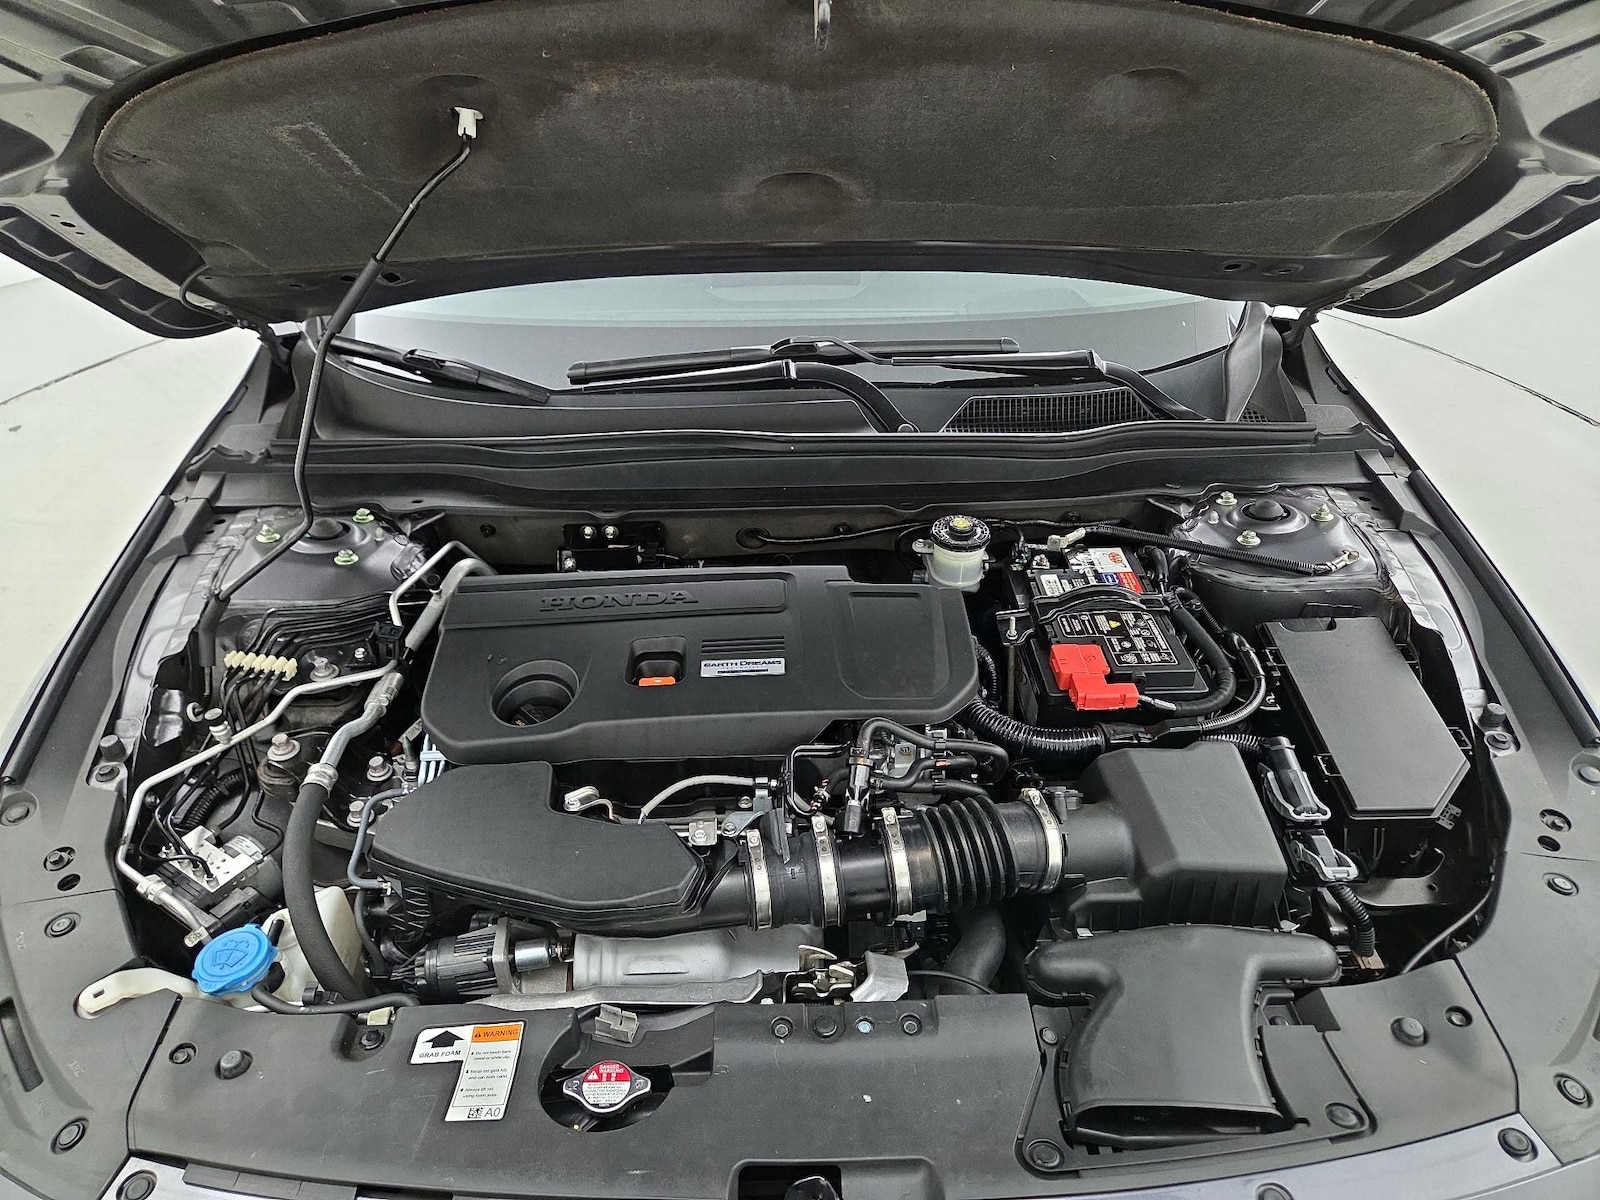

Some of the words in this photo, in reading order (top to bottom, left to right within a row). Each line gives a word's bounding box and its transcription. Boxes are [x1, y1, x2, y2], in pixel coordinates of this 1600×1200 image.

[538, 590, 699, 612] HONDA
[482, 1029, 518, 1038] WARNING
[484, 1107, 501, 1117] A0
